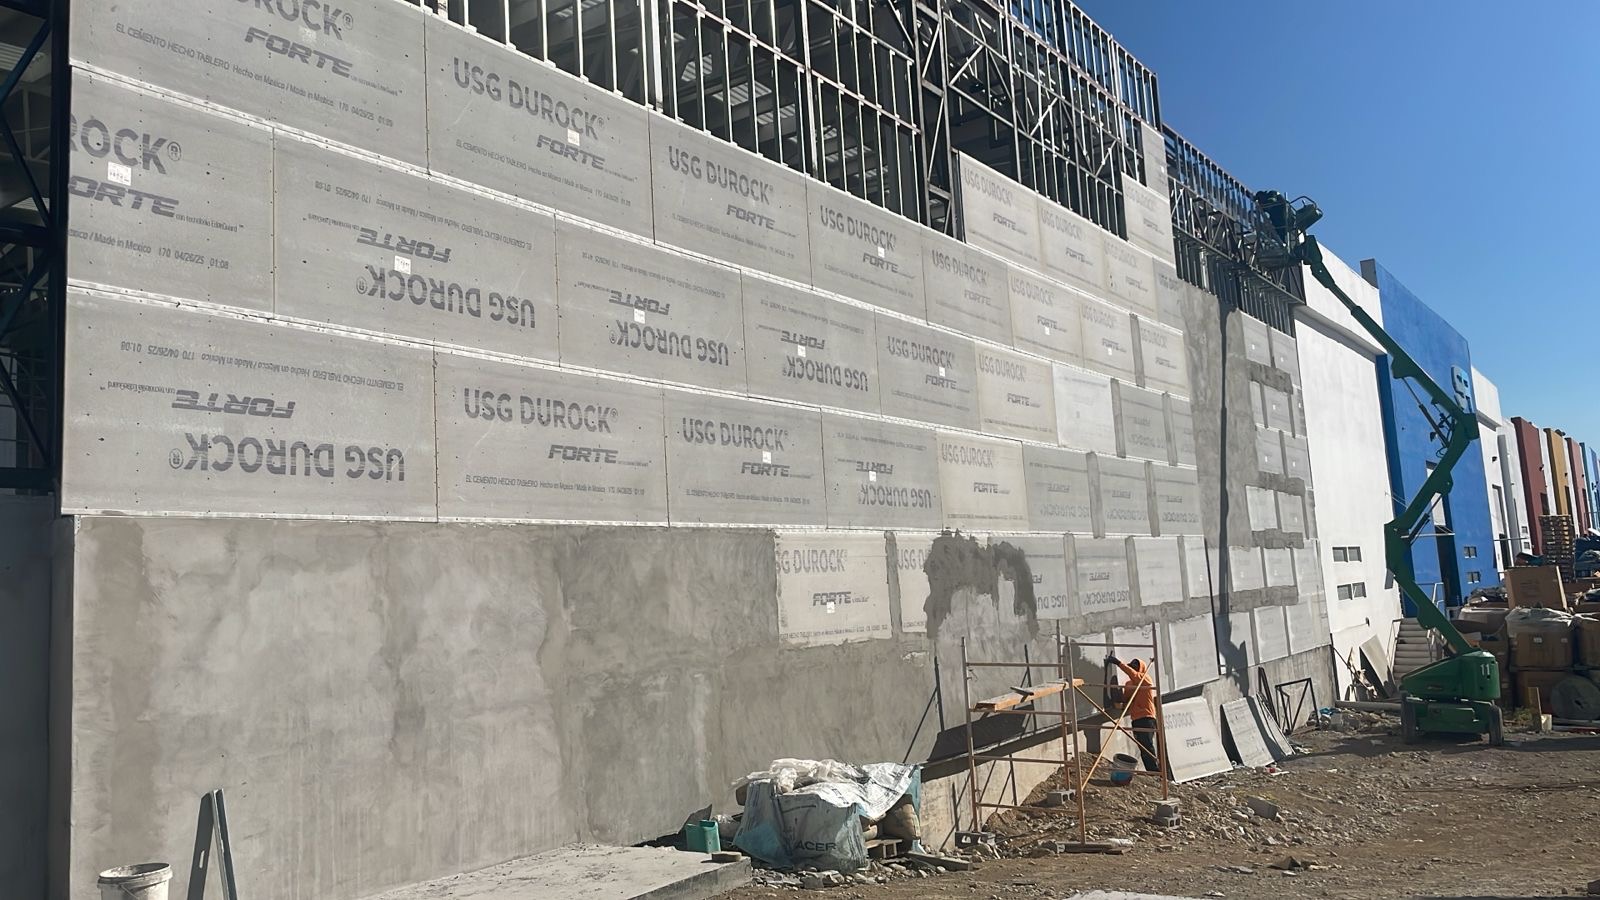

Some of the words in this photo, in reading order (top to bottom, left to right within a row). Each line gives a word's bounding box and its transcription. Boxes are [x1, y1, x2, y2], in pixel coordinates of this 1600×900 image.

[116, 22, 126, 34] EL
[127, 27, 166, 48] CEMENTO
[167, 41, 196, 58] HECHO
[197, 51, 230, 70] TABLERO
[245, 27, 353, 78] FORTE
[453, 57, 501, 101] USG
[536, 134, 605, 170] FORTE
[668, 145, 702, 180] USG
[726, 204, 776, 231] FORTE
[820, 204, 845, 233] USG
[158, 247, 171, 258] 170
[357, 227, 451, 263] FORTE
[862, 252, 899, 275] FORTE
[489, 292, 535, 328] USG
[608, 289, 671, 316] FORTE
[121, 341, 142, 351] 01:08
[780, 330, 826, 350] FORTE
[887, 335, 910, 358] USG
[182, 350, 195, 360] 170
[696, 337, 729, 367] USG
[312, 370, 342, 382] TABLERO
[343, 374, 366, 385] HECHO
[367, 378, 396, 390] CEMENTO
[396, 382, 404, 391] EL
[844, 367, 868, 392] USG
[925, 374, 957, 390] FORTE
[172, 389, 296, 418] FORTE
[464, 387, 513, 422] USG
[1007, 392, 1030, 407] FORTE
[682, 417, 716, 445] USG
[345, 442, 405, 481] USG
[548, 444, 619, 464] FORTE
[741, 462, 790, 477] FORTE
[856, 461, 894, 475] FORTE
[911, 488, 932, 508] USG
[973, 482, 999, 494] FORTE
[812, 591, 852, 607] FORTE
